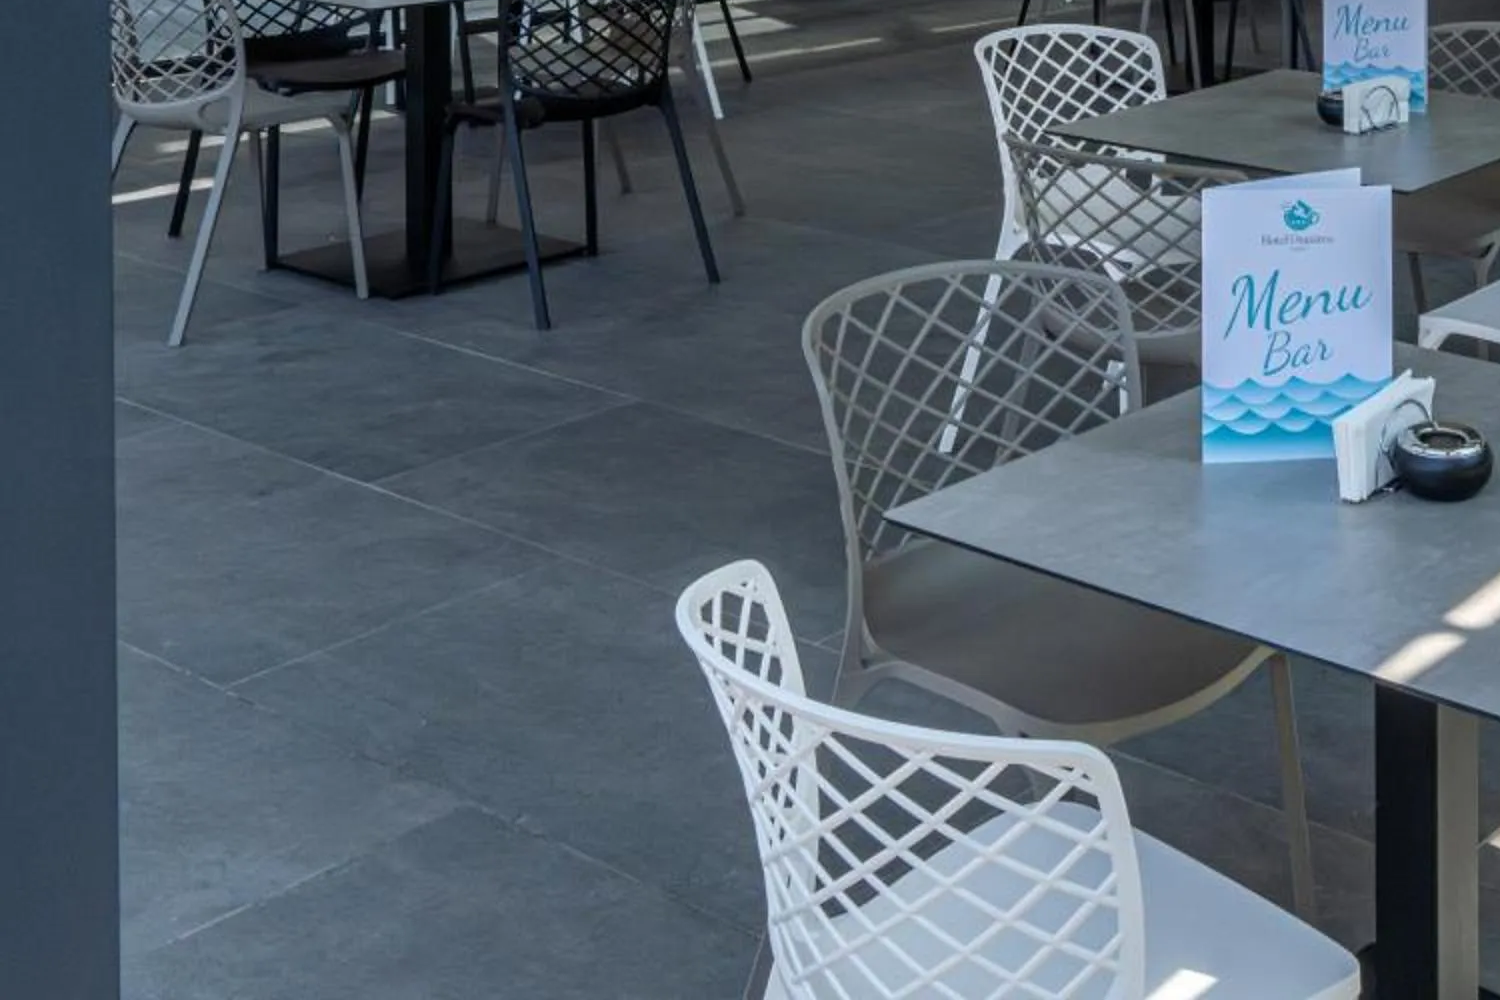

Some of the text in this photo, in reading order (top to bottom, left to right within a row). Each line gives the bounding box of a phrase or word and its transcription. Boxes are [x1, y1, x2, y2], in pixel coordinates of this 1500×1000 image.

[1333, 1, 1410, 40] Menu
[1353, 37, 1392, 63] Bar
[1224, 269, 1374, 341] Menu
[1262, 330, 1334, 377] Bar
